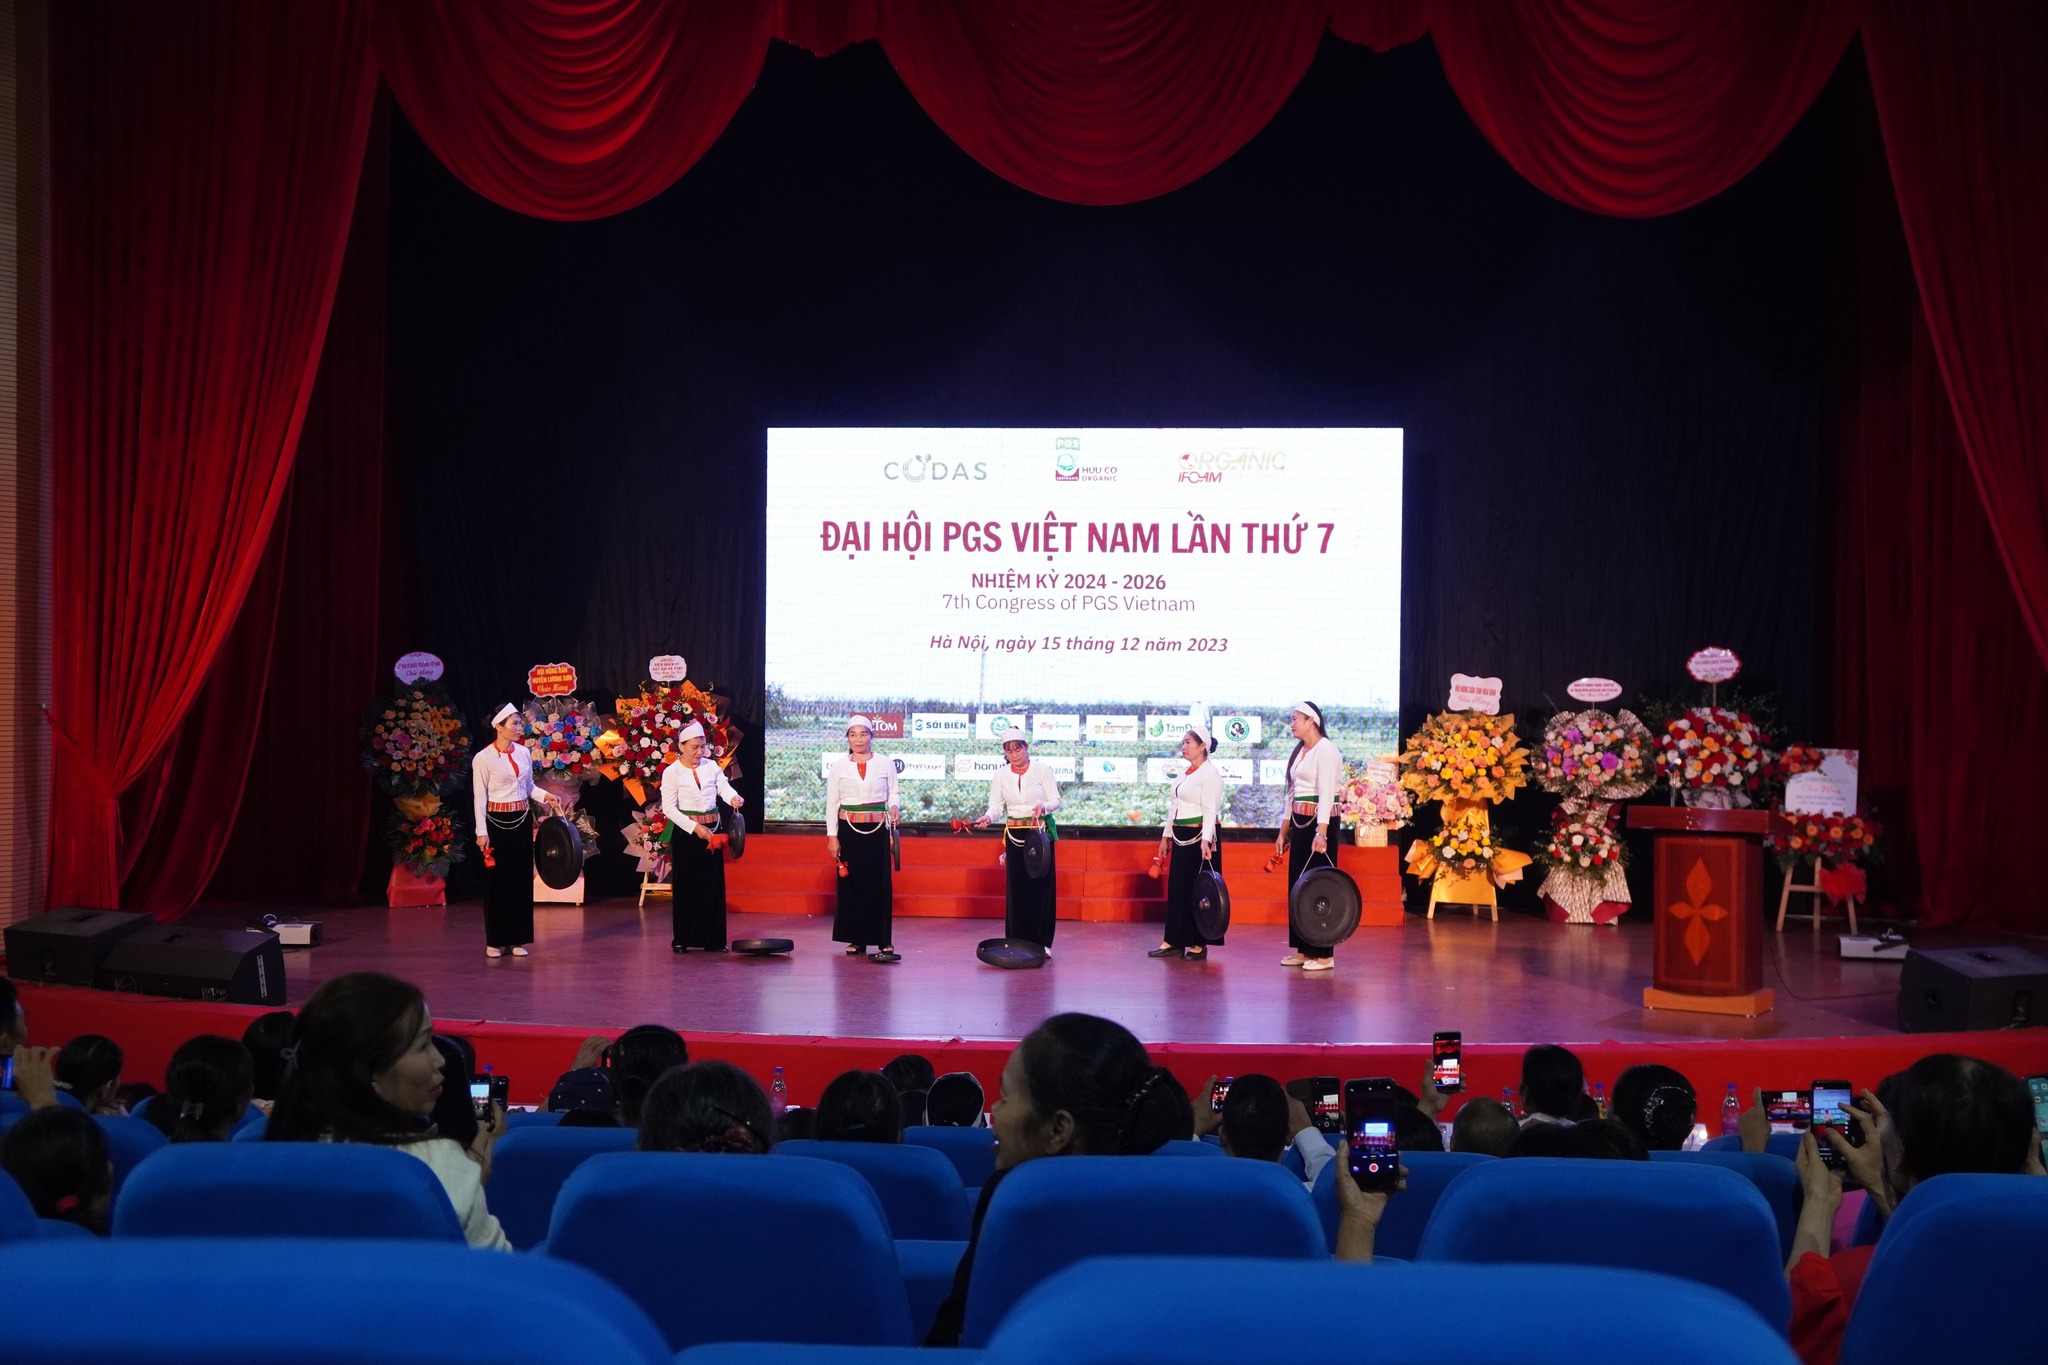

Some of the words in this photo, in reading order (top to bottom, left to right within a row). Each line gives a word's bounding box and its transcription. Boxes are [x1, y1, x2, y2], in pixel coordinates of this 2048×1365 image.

[1057, 439, 1079, 448] PGS
[1178, 471, 1222, 483] IFOAM
[820, 521, 870, 560] ĐẠI
[882, 510, 931, 560] HỘI
[944, 521, 1001, 552] PGS
[1011, 511, 1078, 560] VIỆT
[1088, 522, 1159, 553] NAM
[1172, 510, 1230, 553] LẦN
[1242, 512, 1308, 554] THỨ
[1317, 522, 1334, 553] 7
[971, 568, 1030, 591] NHIỆM
[1036, 569, 1058, 589] KỲ
[1064, 573, 1107, 589] 2024
[1123, 574, 1166, 590] 2026
[942, 594, 970, 610] 7th
[975, 594, 1055, 614] Congress
[1060, 594, 1078, 610] of
[1082, 595, 1118, 611] PGS
[1122, 595, 1195, 611] Vietnam
[930, 635, 952, 650] Hà
[957, 635, 990, 652] Nội,
[995, 636, 1036, 653] ngày
[1041, 636, 1061, 650] 15
[1066, 636, 1115, 653] tháng
[1120, 637, 1140, 650] 12
[1145, 637, 1182, 651] năm
[1187, 638, 1229, 652] 2023
